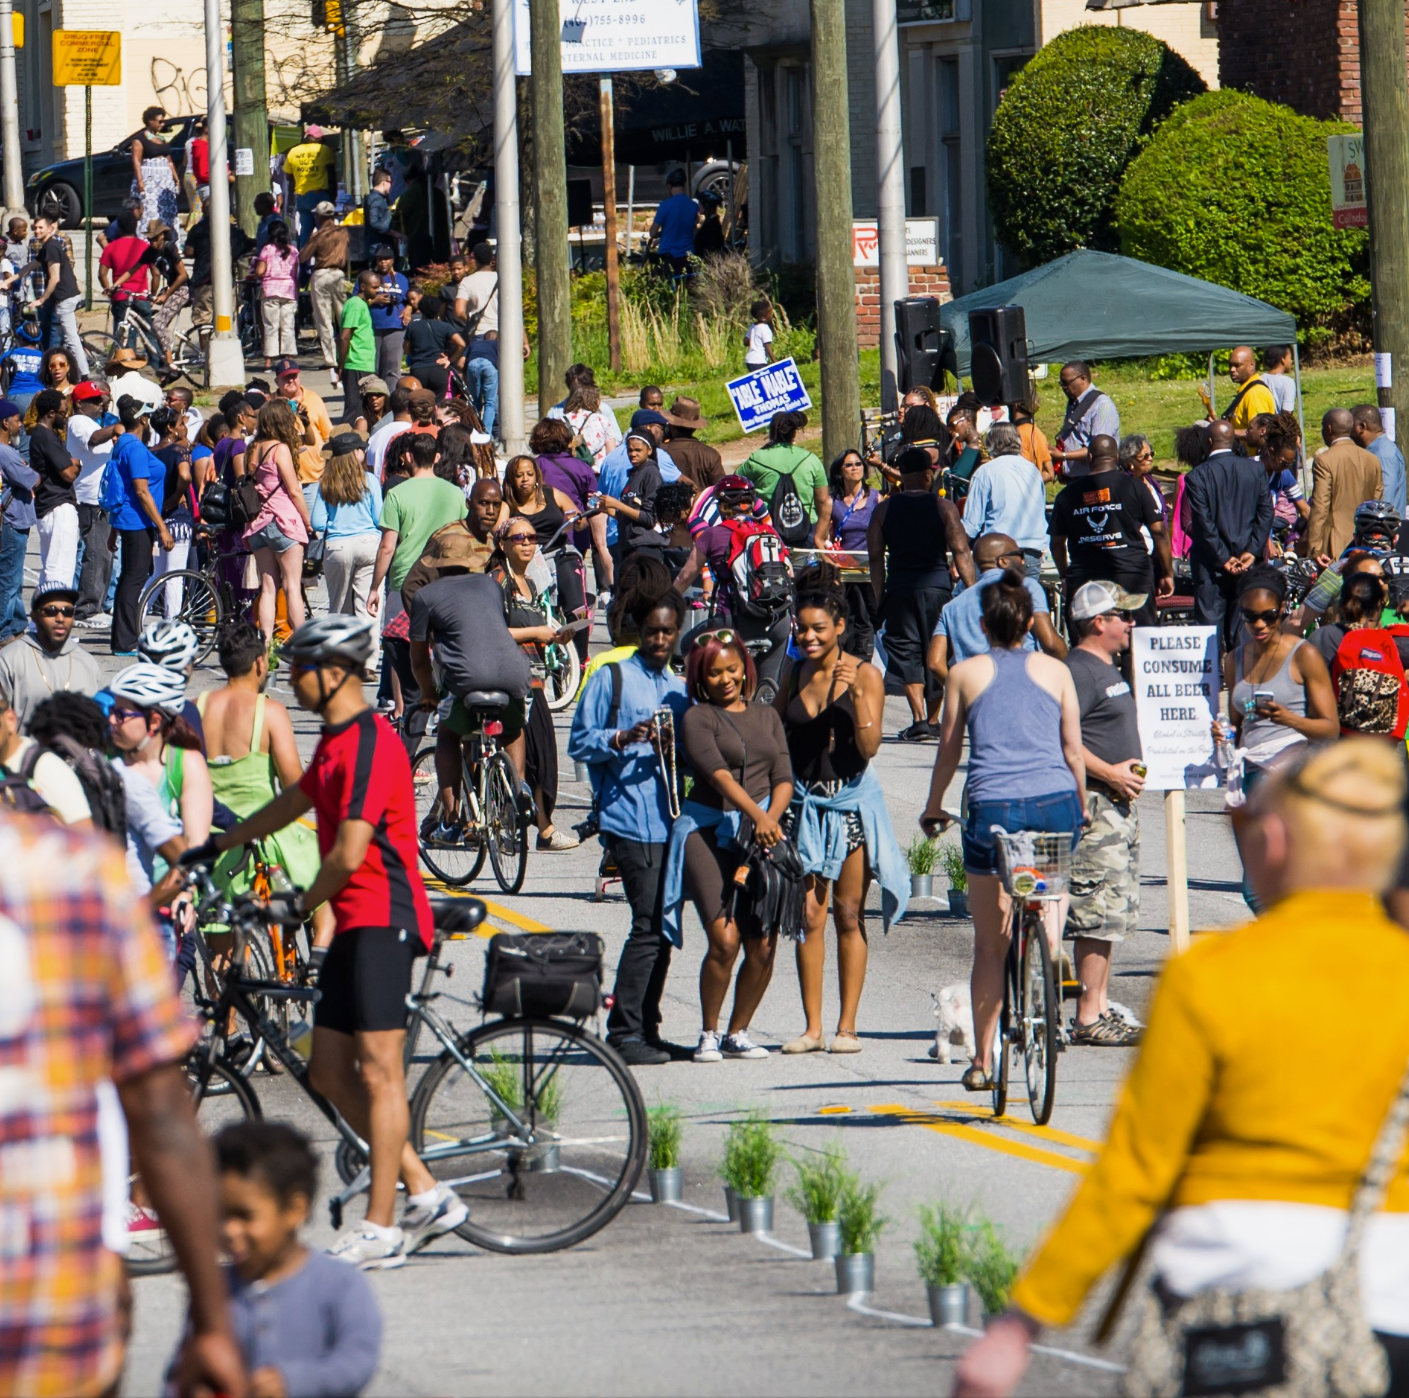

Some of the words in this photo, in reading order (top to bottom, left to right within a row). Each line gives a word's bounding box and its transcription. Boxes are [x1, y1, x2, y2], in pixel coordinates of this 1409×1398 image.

[565, 38, 614, 48] PRACTICE
[627, 35, 687, 46] PEDIATRICS
[562, 52, 606, 62] NTERNAL
[610, 50, 658, 61] MEDICINE
[651, 123, 698, 143] WILLIE
[907, 237, 936, 245] DESIGNERS
[752, 393, 791, 415] THOMAS
[1073, 506, 1090, 516] AIR
[1091, 503, 1123, 513] FORCE
[1149, 636, 1201, 650] PLEASE
[1143, 659, 1213, 674] CONSUME
[1147, 684, 1171, 697] ALL
[1175, 683, 1211, 697] BEER
